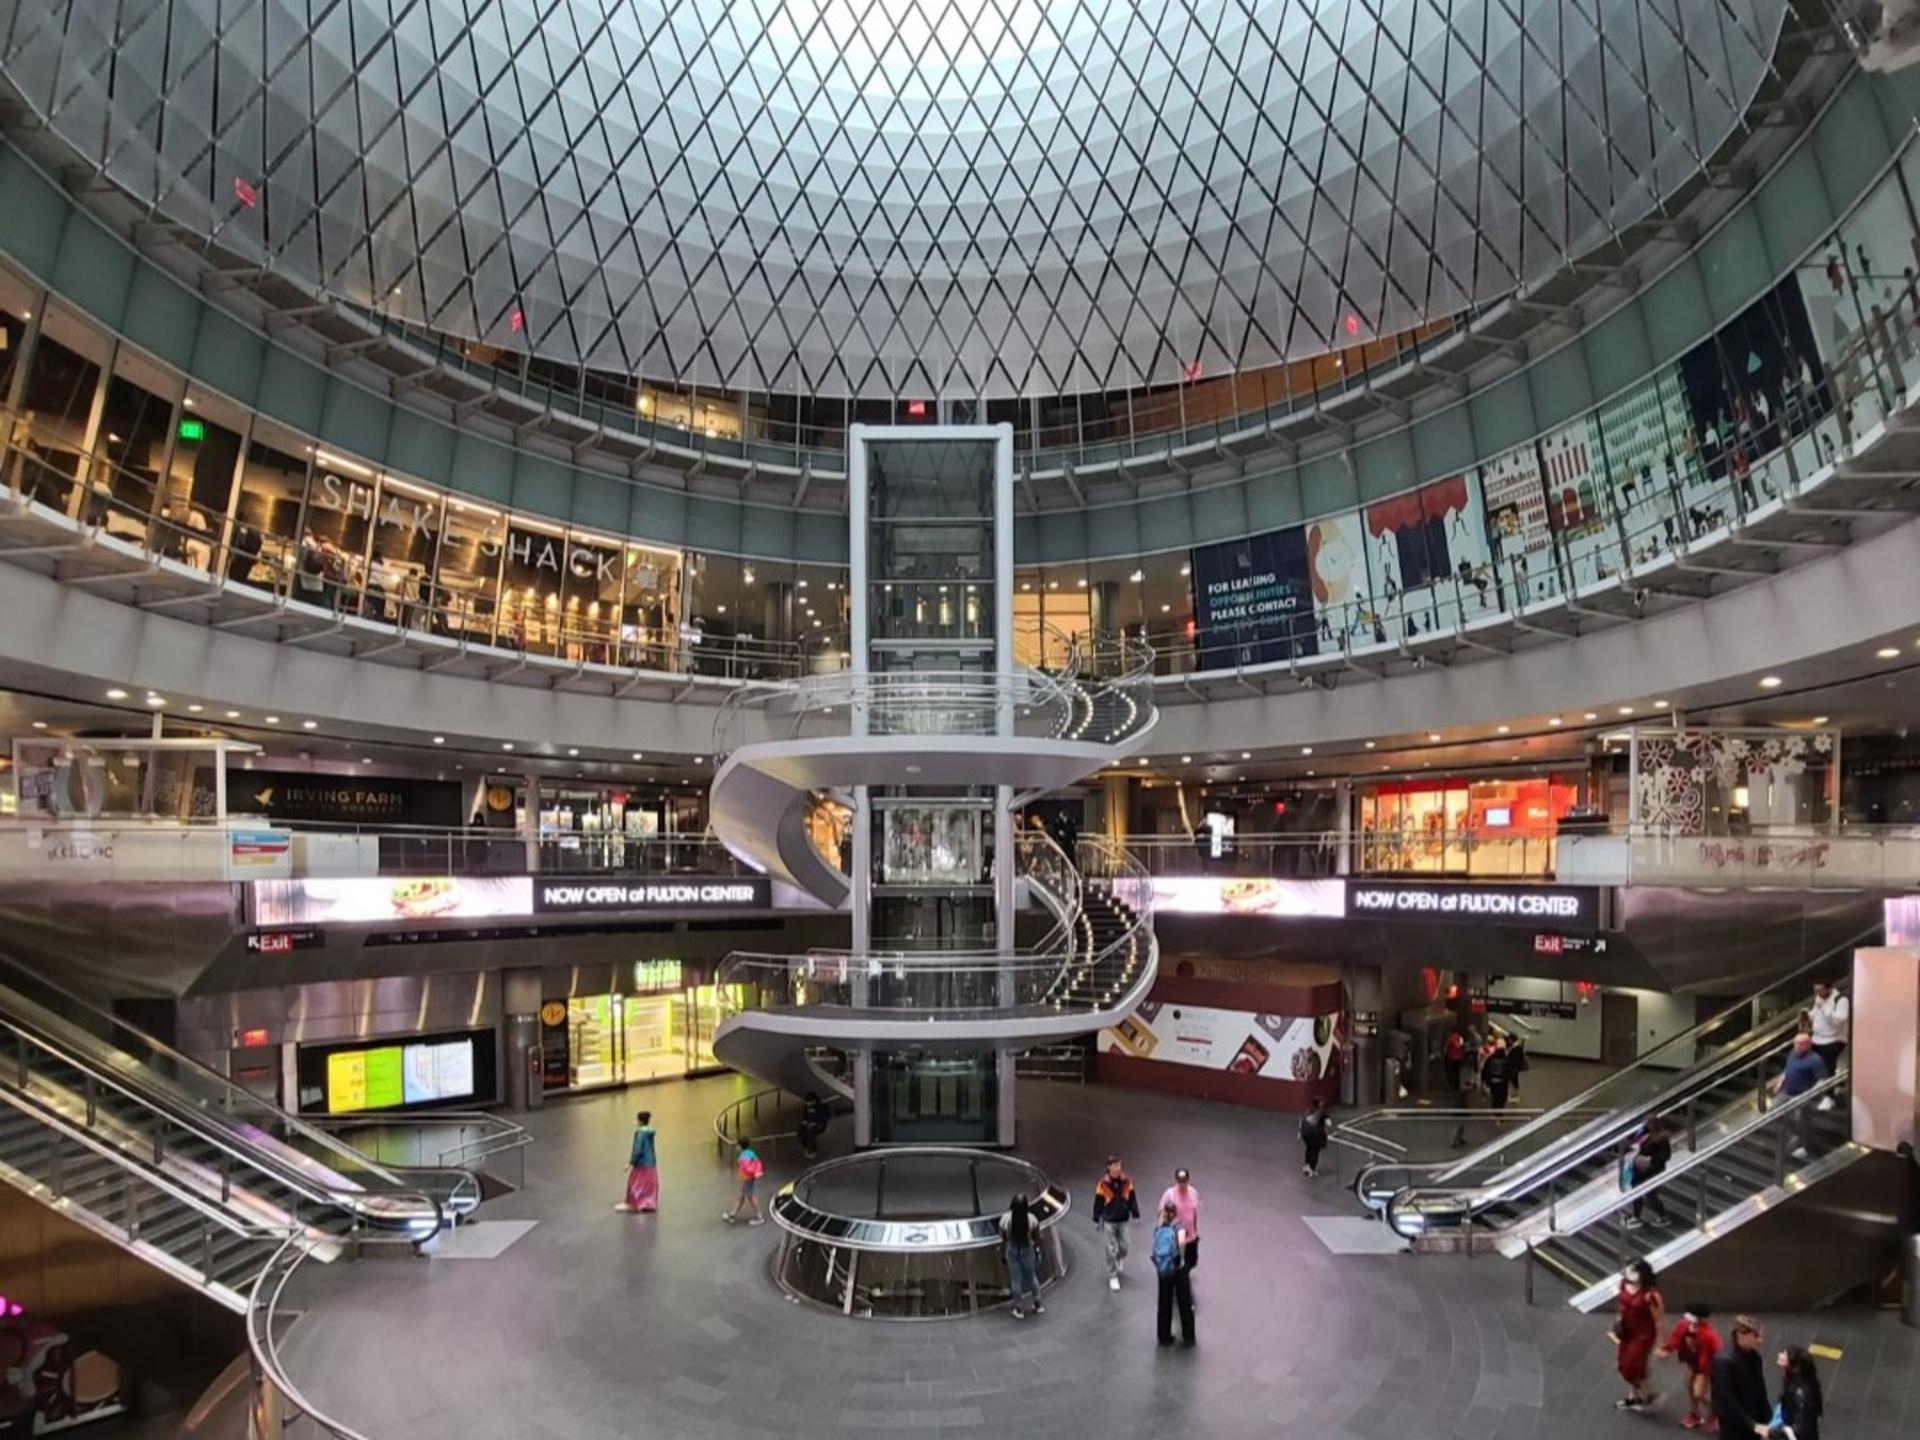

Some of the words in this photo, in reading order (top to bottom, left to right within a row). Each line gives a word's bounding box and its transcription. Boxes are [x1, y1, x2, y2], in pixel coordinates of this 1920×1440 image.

[319, 473, 462, 547] SHAKE
[480, 526, 618, 582] SHACK
[1208, 581, 1230, 594] FOR
[1210, 605, 1246, 621] PLEASE
[1248, 596, 1297, 615] CONTACT
[286, 787, 350, 804] IRVING
[355, 790, 403, 806] FARM
[544, 887, 585, 904] NOW
[585, 886, 627, 903] OPEN
[629, 886, 645, 903] at
[647, 885, 700, 902] FULTON
[700, 884, 755, 902] CENTER
[1355, 890, 1396, 909] NOW
[1397, 891, 1439, 910] OPEN
[1440, 892, 1458, 910] at
[1459, 893, 1516, 913] FULTON
[1517, 894, 1579, 916] CENTER
[260, 934, 290, 951] Exit
[1534, 934, 1560, 952] Exit
